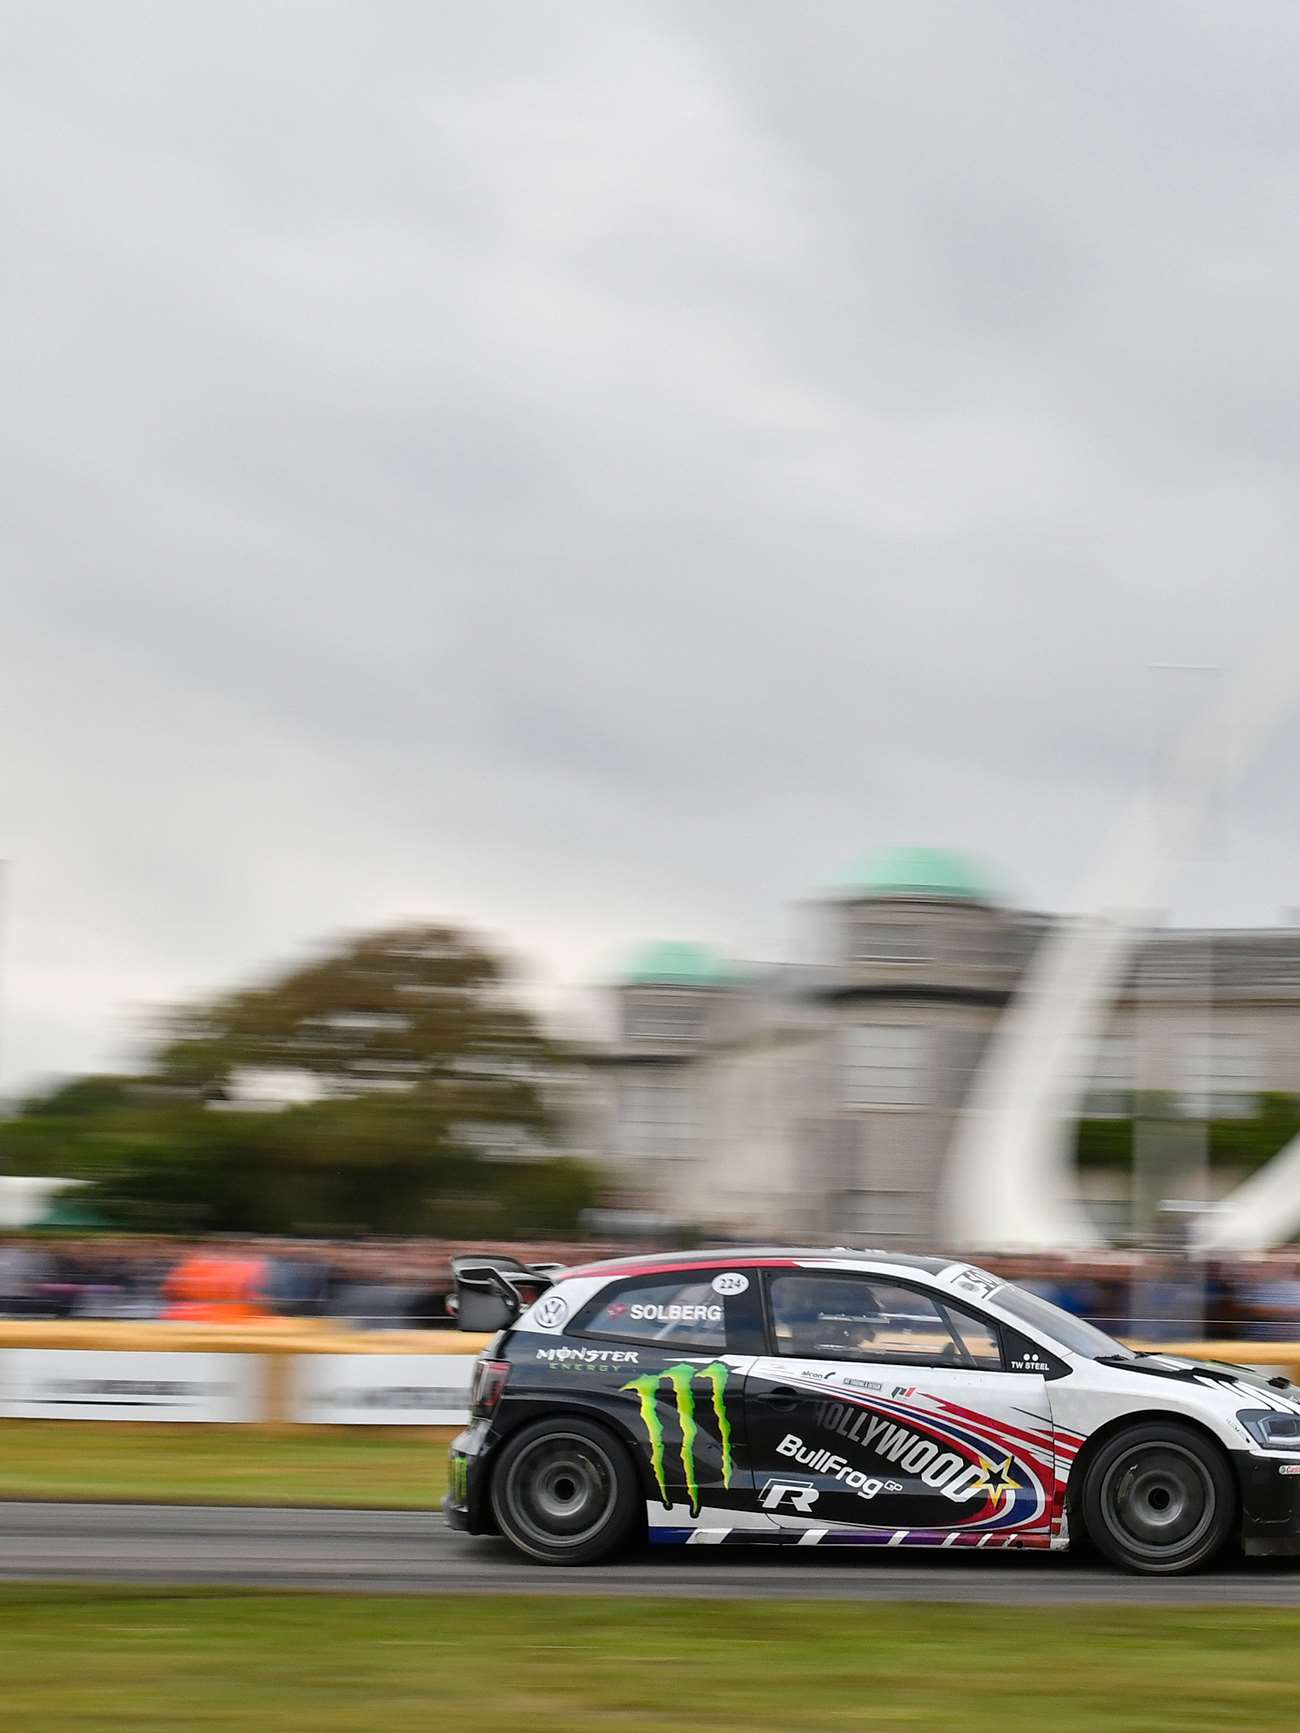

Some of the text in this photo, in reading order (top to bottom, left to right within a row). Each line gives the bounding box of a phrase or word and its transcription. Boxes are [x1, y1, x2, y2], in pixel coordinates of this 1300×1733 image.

[718, 1278, 741, 1289] 224
[629, 1304, 723, 1321] SOLBERG
[536, 1346, 639, 1364] MONSTER
[549, 1362, 621, 1372] ENERGY
[1011, 1360, 1050, 1371] TW STEEL
[775, 1433, 904, 1500] BullFrog GP
